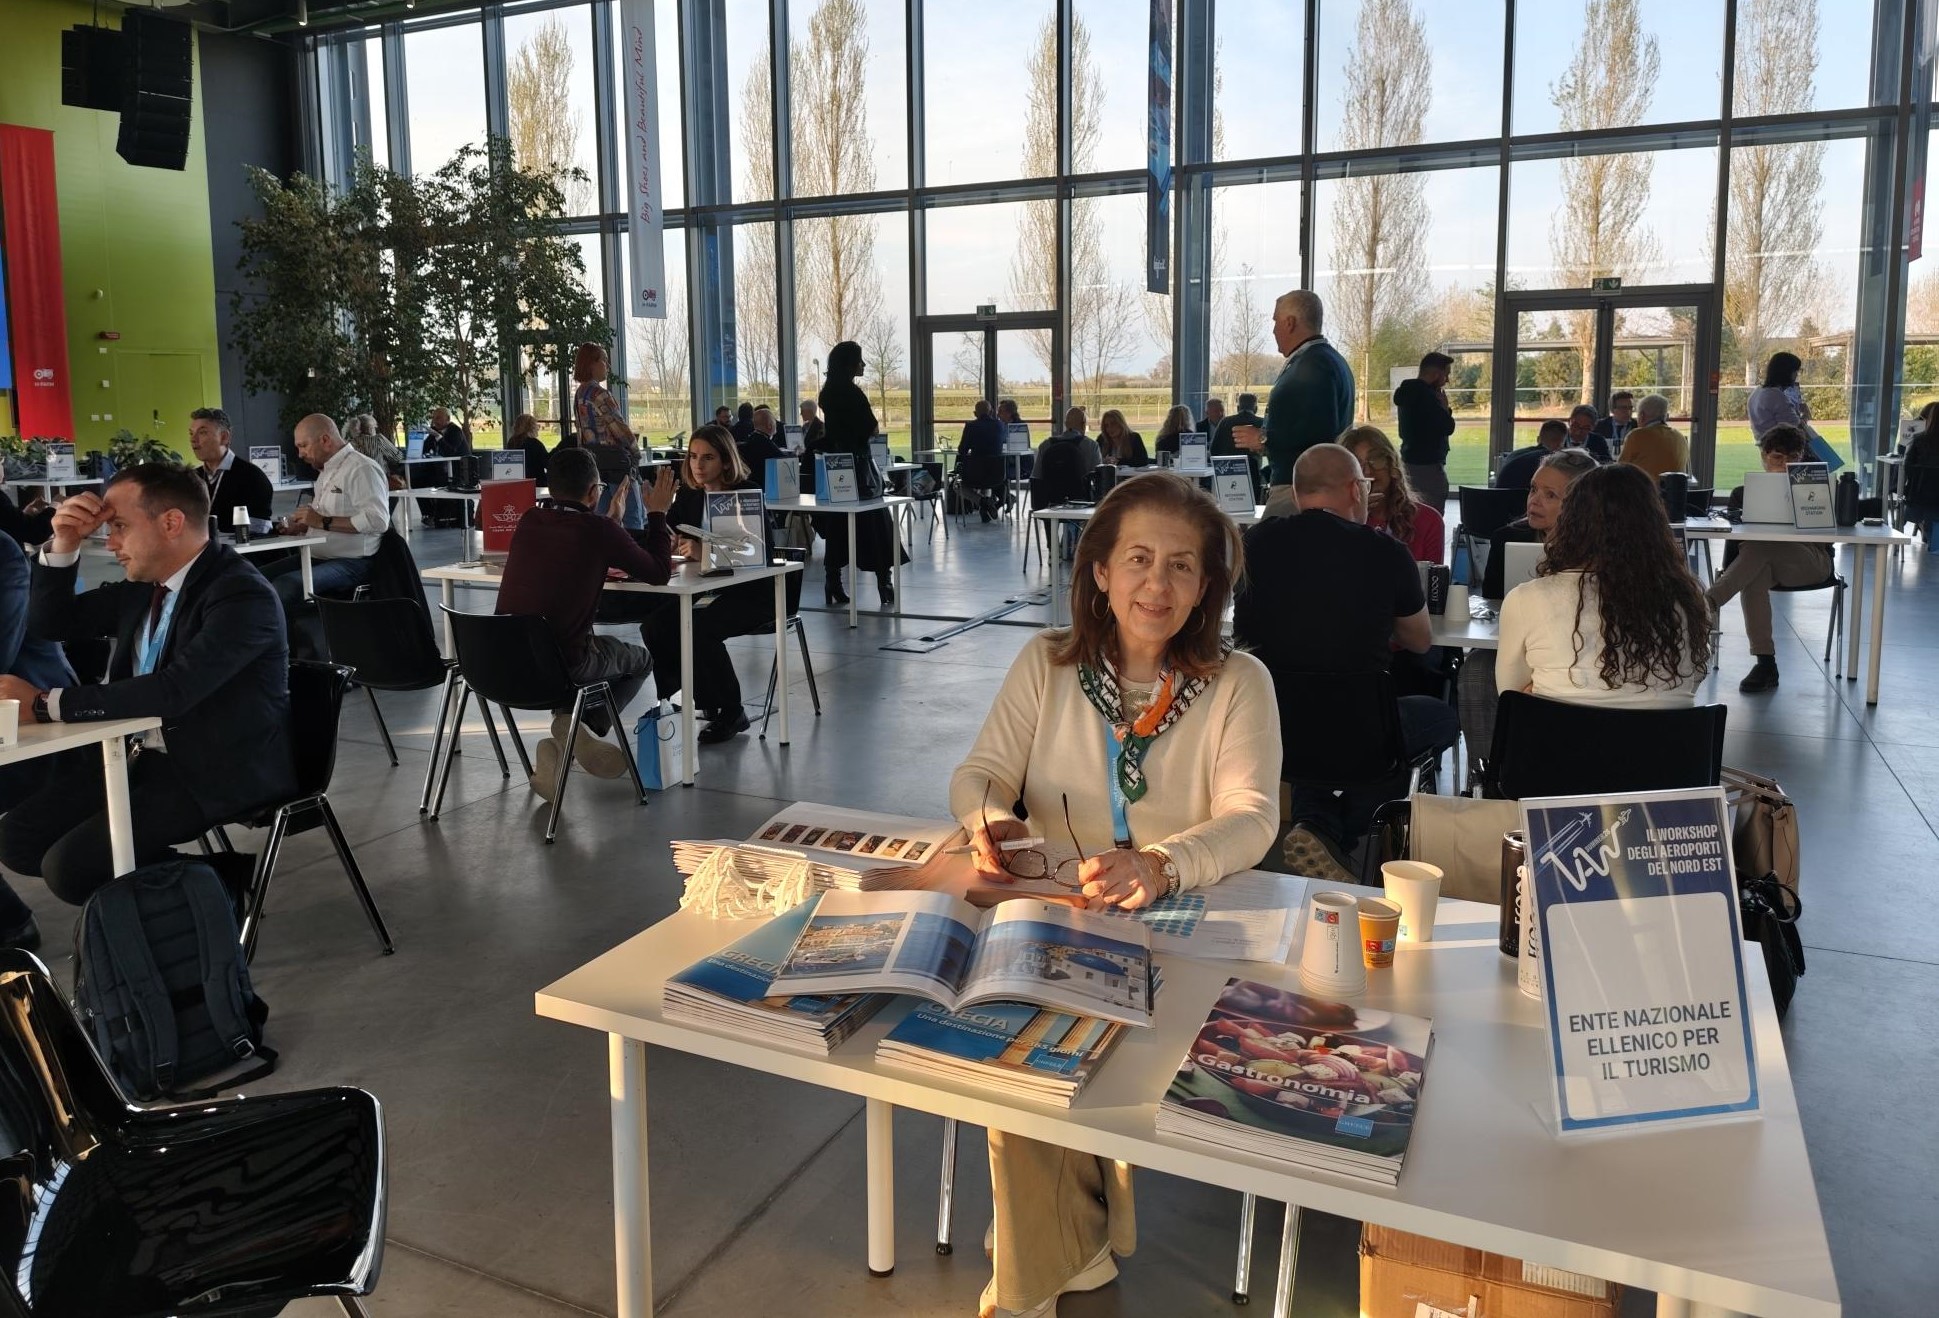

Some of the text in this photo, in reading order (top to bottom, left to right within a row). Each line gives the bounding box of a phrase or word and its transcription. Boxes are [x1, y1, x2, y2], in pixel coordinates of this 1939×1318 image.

[632, 26, 652, 224] Big Shoes and Beautiful Mind
[1646, 824, 1718, 842] IL WORKSHOP
[1627, 841, 1721, 860] DEGLI AEROPORTI
[1647, 857, 1722, 876] DEL NORD EST
[1569, 1001, 1732, 1033] ENTE NAZIONALE
[917, 1012, 937, 1025] Una
[938, 1017, 1006, 1040] destinazione
[1005, 1036, 1025, 1046] per
[1049, 1045, 1084, 1058] giorni
[1587, 1027, 1719, 1057] ELLENICO PER
[1197, 1053, 1370, 1105] Gastronomia
[1602, 1052, 1710, 1080] IL TURISMO
